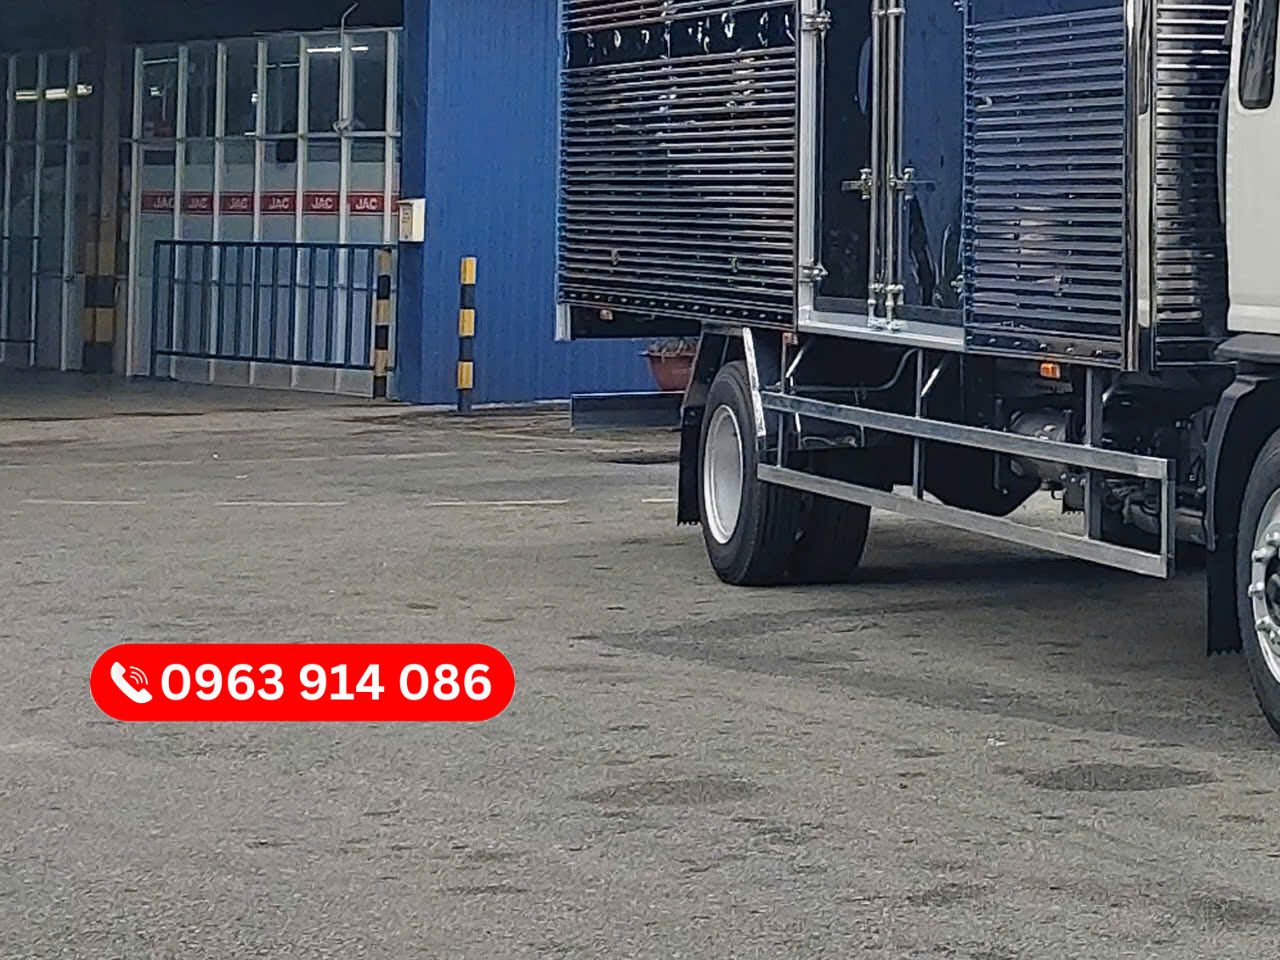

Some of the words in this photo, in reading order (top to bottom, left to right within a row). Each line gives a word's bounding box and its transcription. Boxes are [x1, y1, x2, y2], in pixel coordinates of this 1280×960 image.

[268, 197, 291, 209] JAC
[311, 197, 334, 210] JAC
[355, 197, 378, 210] JAC
